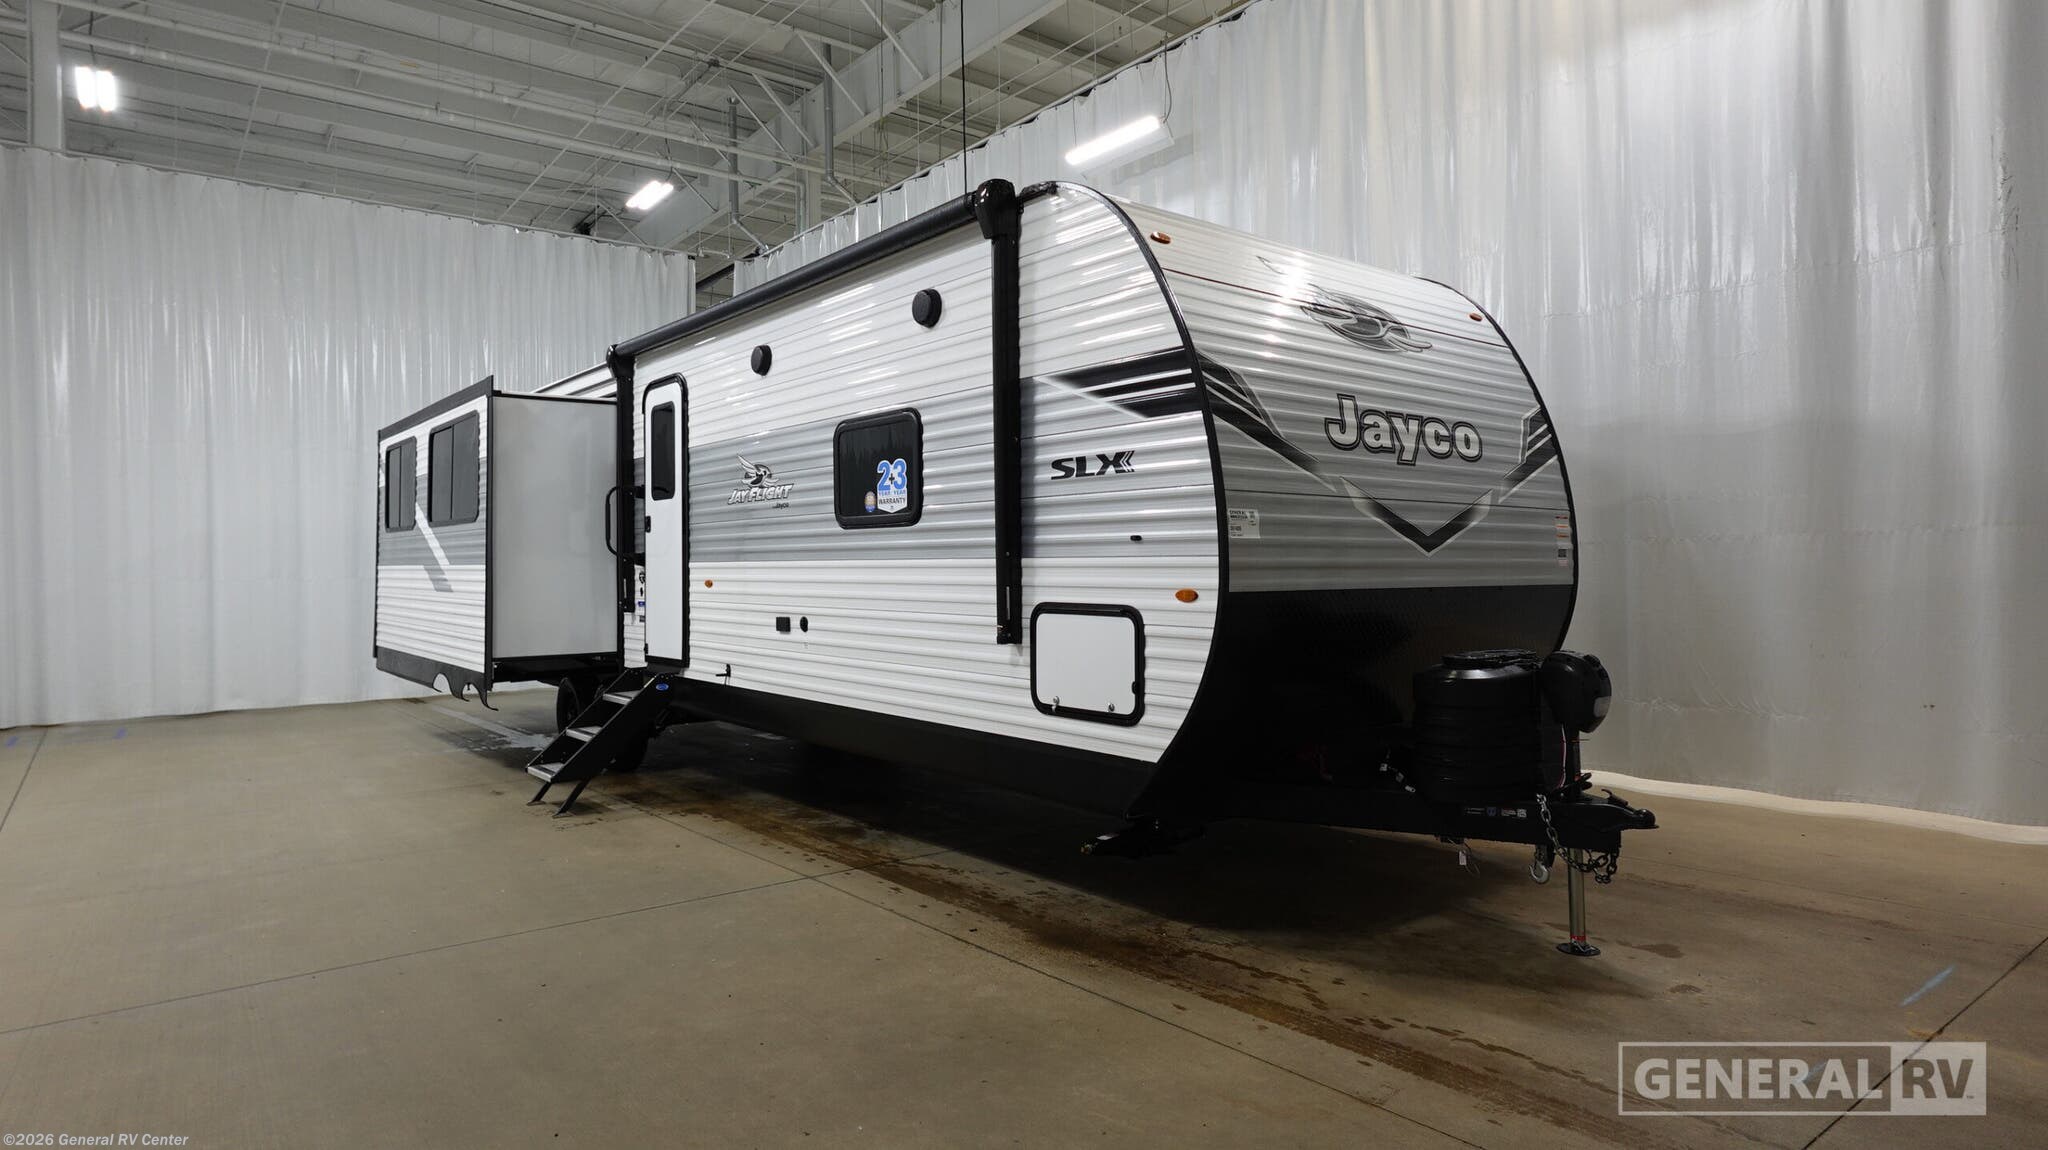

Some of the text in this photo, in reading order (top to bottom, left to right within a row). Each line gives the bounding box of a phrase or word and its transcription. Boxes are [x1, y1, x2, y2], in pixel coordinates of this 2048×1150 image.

[1325, 393, 1483, 466] Jayco
[1051, 450, 1135, 480] SLX
[727, 483, 794, 505] JAY FLIGHT
